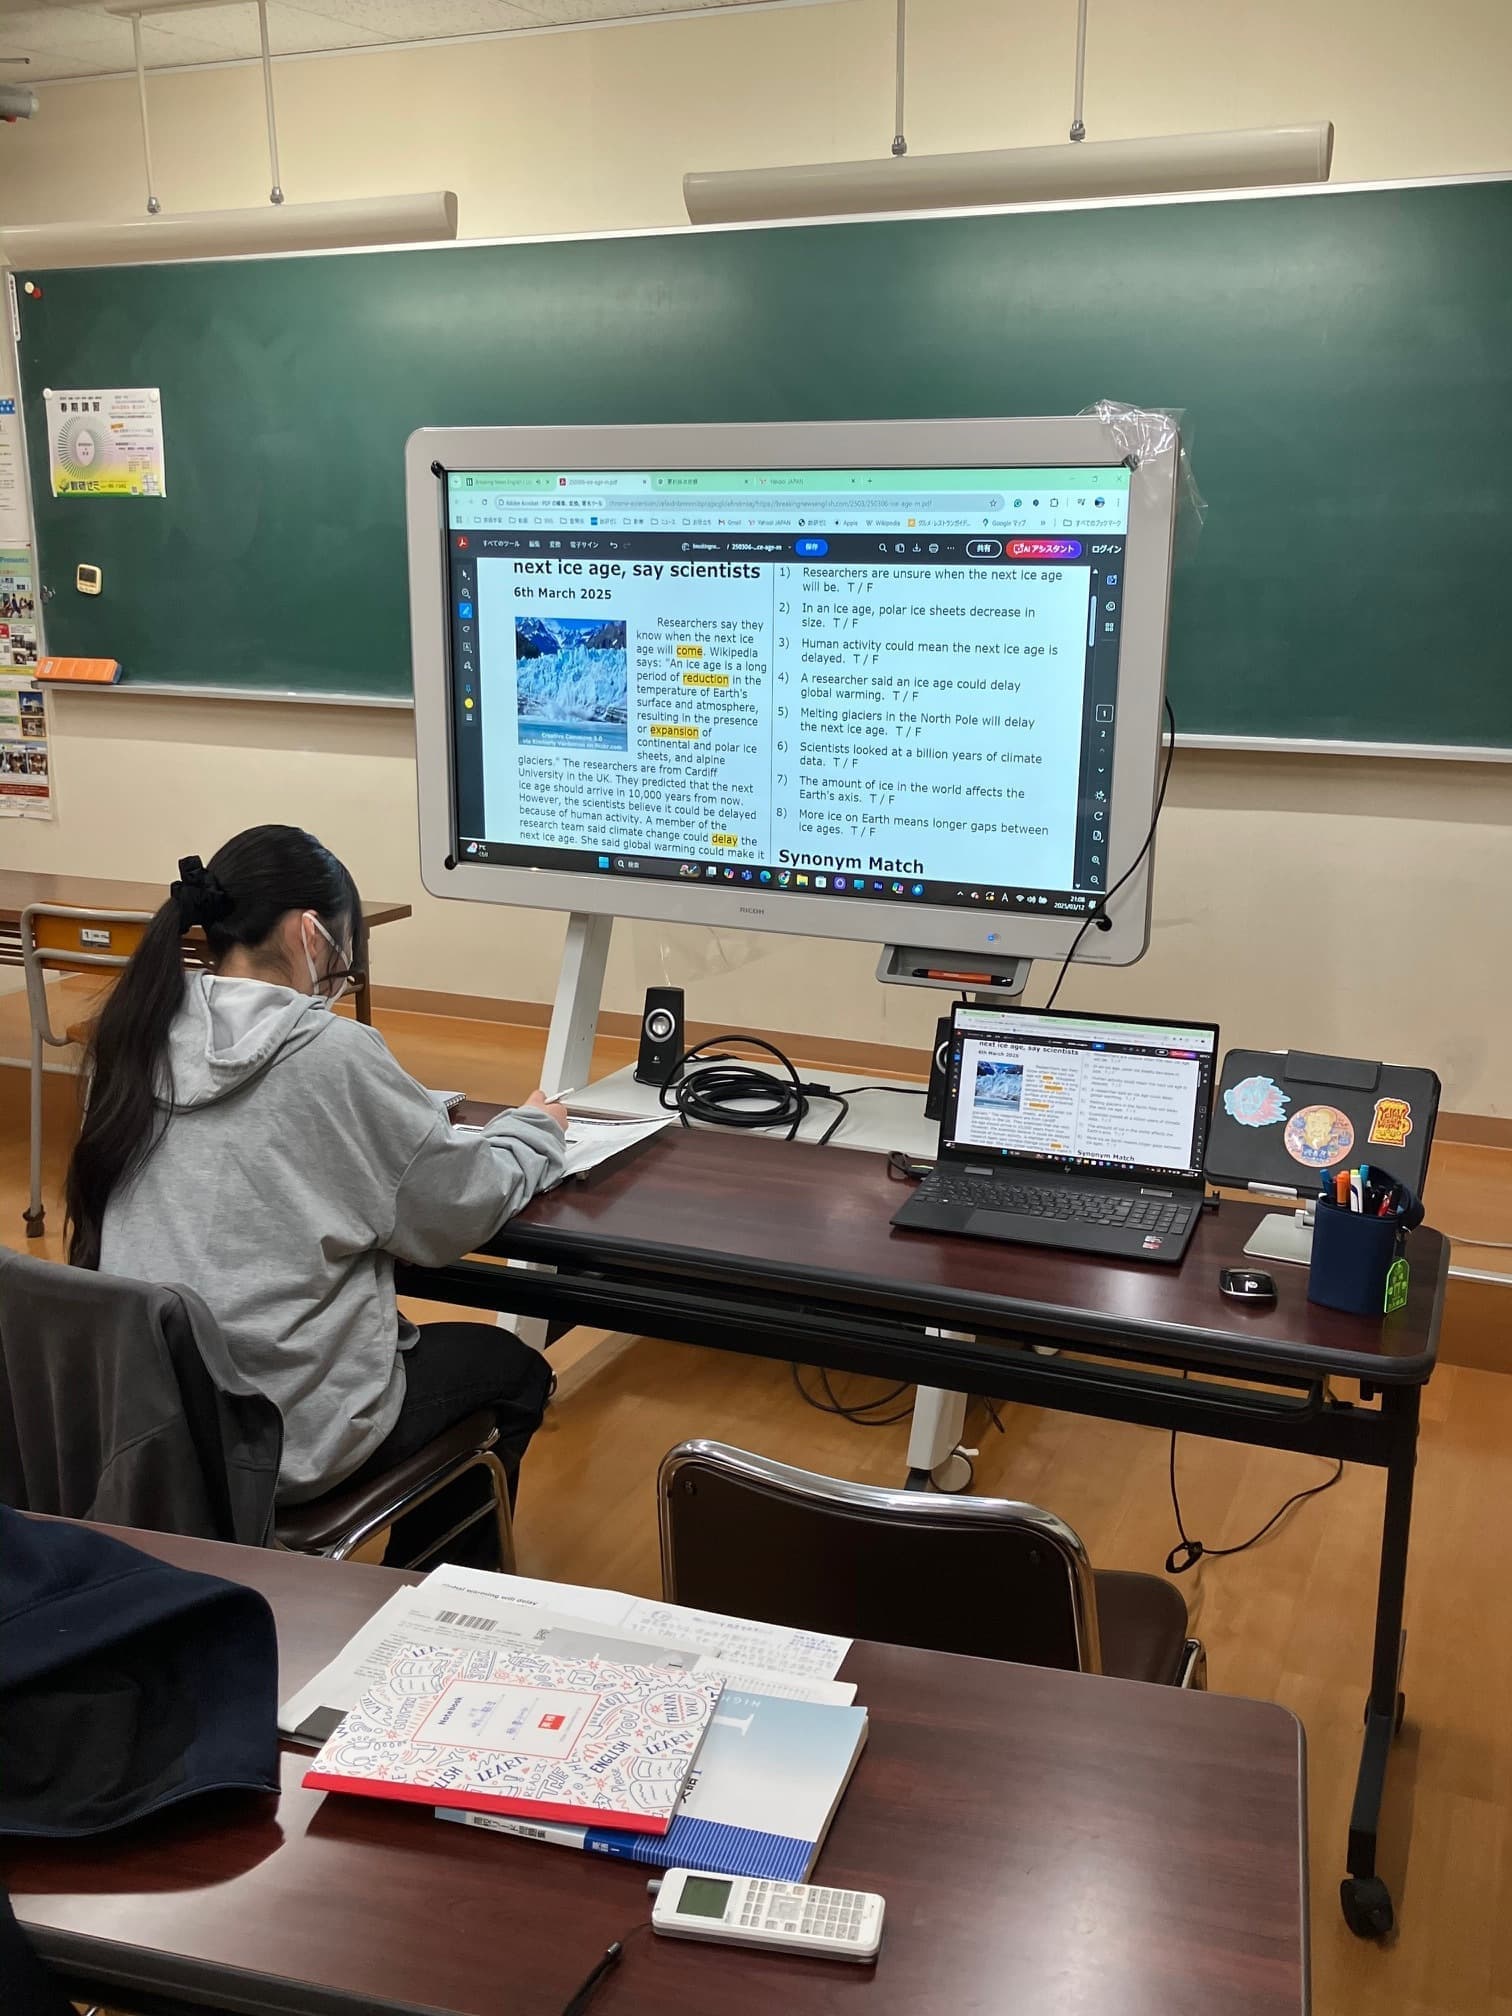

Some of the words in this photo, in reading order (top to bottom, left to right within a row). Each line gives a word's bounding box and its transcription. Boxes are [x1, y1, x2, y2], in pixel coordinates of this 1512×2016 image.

[60, 401, 101, 413] 春期講習
[1030, 544, 1075, 553] アシスタント
[1091, 544, 1122, 554] ログイン
[513, 558, 552, 574] next
[558, 559, 582, 575] ice
[588, 563, 625, 579] age,
[632, 564, 664, 580] say
[670, 561, 760, 578] scientists
[780, 565, 790, 577] 1)
[803, 566, 868, 577] Researchers
[893, 570, 931, 578] unsure
[934, 568, 964, 578] when
[968, 569, 987, 579] the
[991, 569, 1017, 579] next
[1020, 569, 1037, 580] ice
[1040, 572, 1062, 583] age
[513, 586, 533, 597] 6th
[538, 586, 575, 598] March
[580, 587, 611, 599] 2025
[802, 581, 819, 591] will
[823, 581, 839, 591] be.
[779, 601, 790, 613] 2)
[802, 602, 813, 612] In
[833, 602, 848, 612] ice
[851, 605, 874, 615] age,
[879, 604, 907, 616] polar
[910, 604, 925, 614] ice
[929, 605, 966, 616] sheets
[969, 606, 1021, 617] decrease
[1024, 607, 1035, 617] in
[657, 617, 717, 628] Researchers
[720, 621, 737, 631] say
[740, 619, 763, 631] they
[801, 617, 825, 627] size.
[636, 630, 662, 640] know
[664, 630, 691, 641] when
[694, 631, 710, 641] the
[714, 632, 736, 642] next
[739, 633, 754, 643] ice
[636, 646, 654, 655] age
[655, 644, 672, 654] will
[676, 647, 706, 655] come.
[709, 646, 758, 659] Wikipedia
[778, 636, 789, 648] 3)
[801, 637, 839, 648] Human
[842, 638, 881, 651] activity
[885, 639, 913, 650] could
[917, 643, 948, 651] mean
[952, 642, 971, 652] the
[974, 642, 1000, 653] next
[1003, 643, 1019, 654] ice
[1023, 647, 1044, 657] age
[636, 659, 661, 669] says:
[665, 658, 682, 667] "An
[686, 658, 700, 668] ice
[702, 662, 721, 671] age
[743, 661, 766, 673] long
[801, 652, 845, 665] delayed.
[636, 670, 666, 682] period
[669, 671, 680, 681] of
[682, 672, 729, 683] reduction
[732, 674, 741, 683] in
[744, 674, 761, 684] the
[636, 683, 697, 697] temperature
[699, 686, 710, 696] of
[713, 687, 747, 698] Earth's
[636, 697, 671, 707] surface
[674, 698, 692, 708] and
[696, 699, 758, 714] atmosphere,
[636, 710, 678, 723] resulting
[681, 712, 690, 722] in
[693, 713, 712, 723] the
[713, 716, 758, 727] presence
[637, 725, 647, 733] or
[649, 724, 699, 738] expansion
[701, 726, 712, 736] of
[637, 737, 692, 749] continental
[693, 740, 711, 750] and
[712, 741, 740, 754] polar
[743, 743, 757, 752] ice
[636, 750, 672, 763] sheets,
[674, 752, 693, 762] and
[694, 753, 725, 766] alpine
[778, 847, 861, 872] Synonym
[869, 854, 923, 874] Match
[1001, 892, 1009, 902] A
[739, 906, 765, 915] RICOH
[438, 1696, 464, 1725] Notebook
[663, 1693, 680, 1723] THANK
[646, 1730, 695, 1755] LEARN
[589, 1740, 631, 1774] ENGLISH
[536, 1766, 569, 1799] THE
